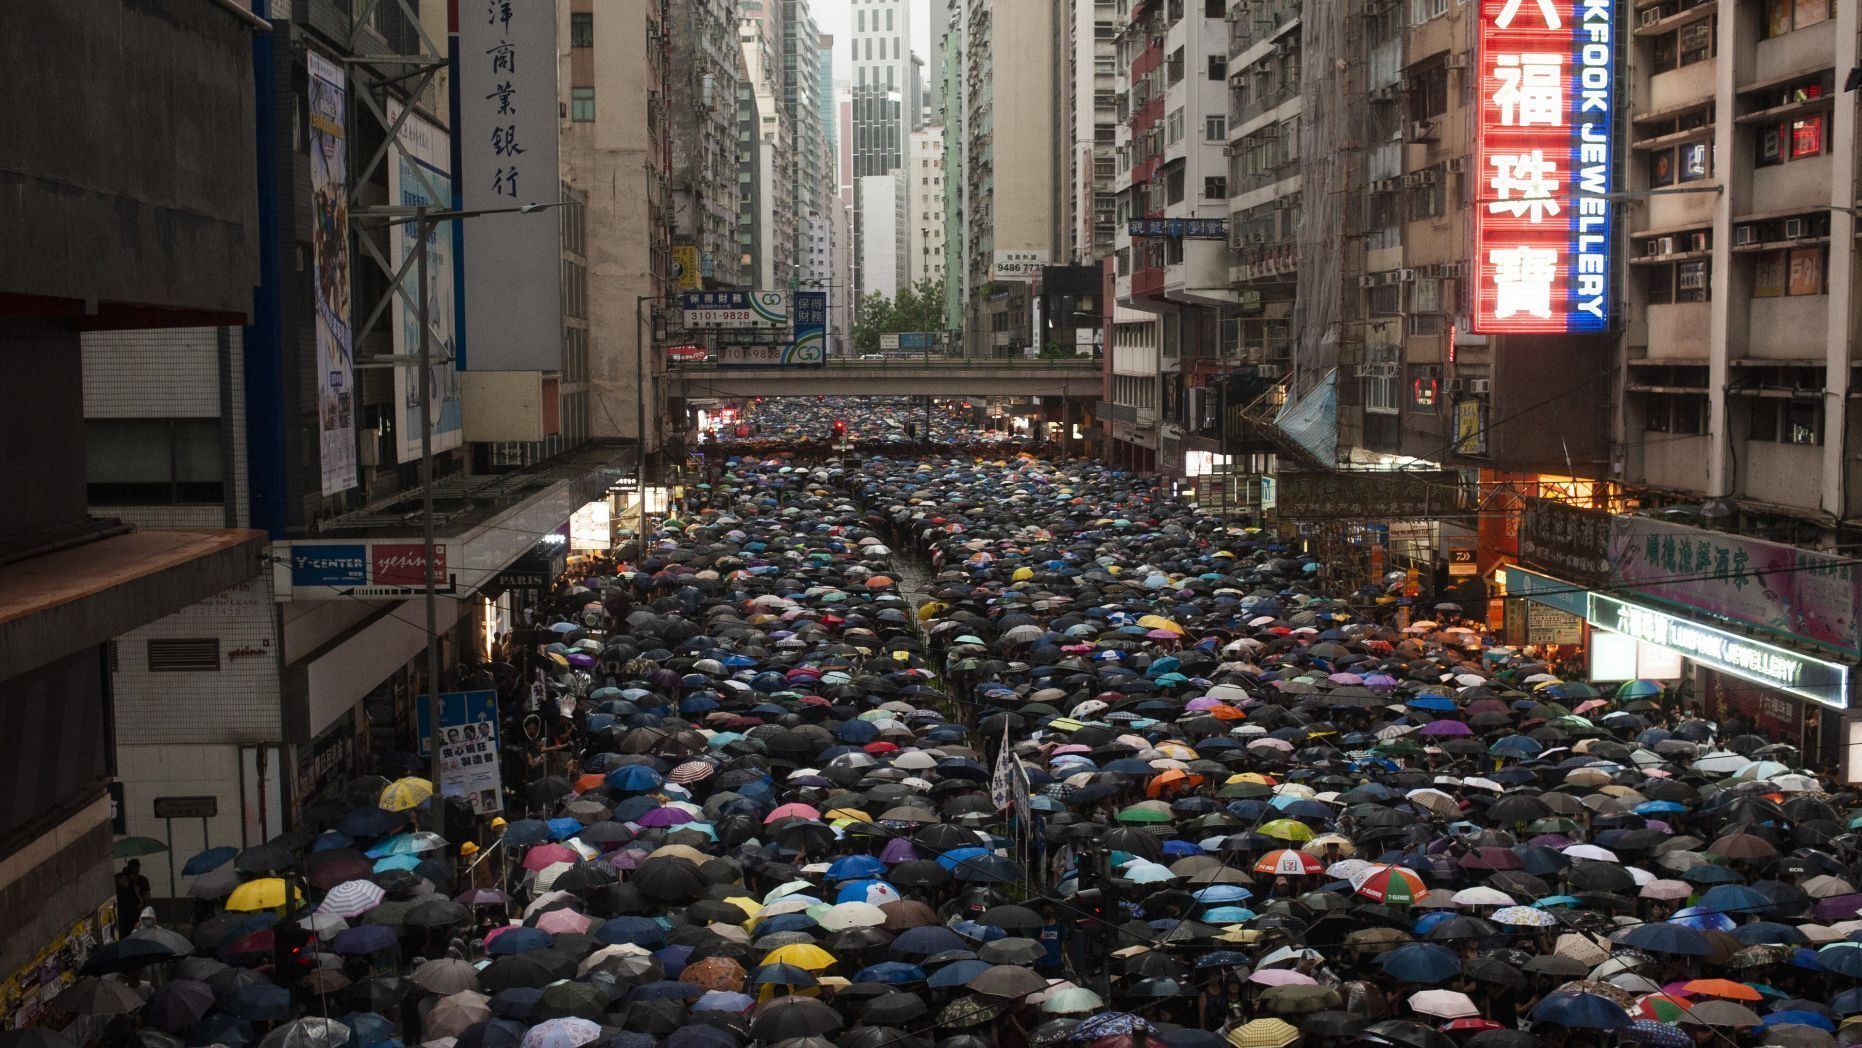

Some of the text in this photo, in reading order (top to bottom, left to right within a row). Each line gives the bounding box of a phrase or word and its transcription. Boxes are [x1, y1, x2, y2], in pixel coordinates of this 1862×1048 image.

[1578, 123, 1609, 320] JEWELLERY
[998, 264, 1021, 272] 9486
[690, 293, 742, 304] 保得財務
[691, 311, 750, 320] 3101-9828
[719, 349, 781, 359] 3101-9828
[297, 556, 363, 569] Y-CENTER
[500, 575, 543, 585] PARIS
[1724, 639, 1797, 682] JEWELLERY
